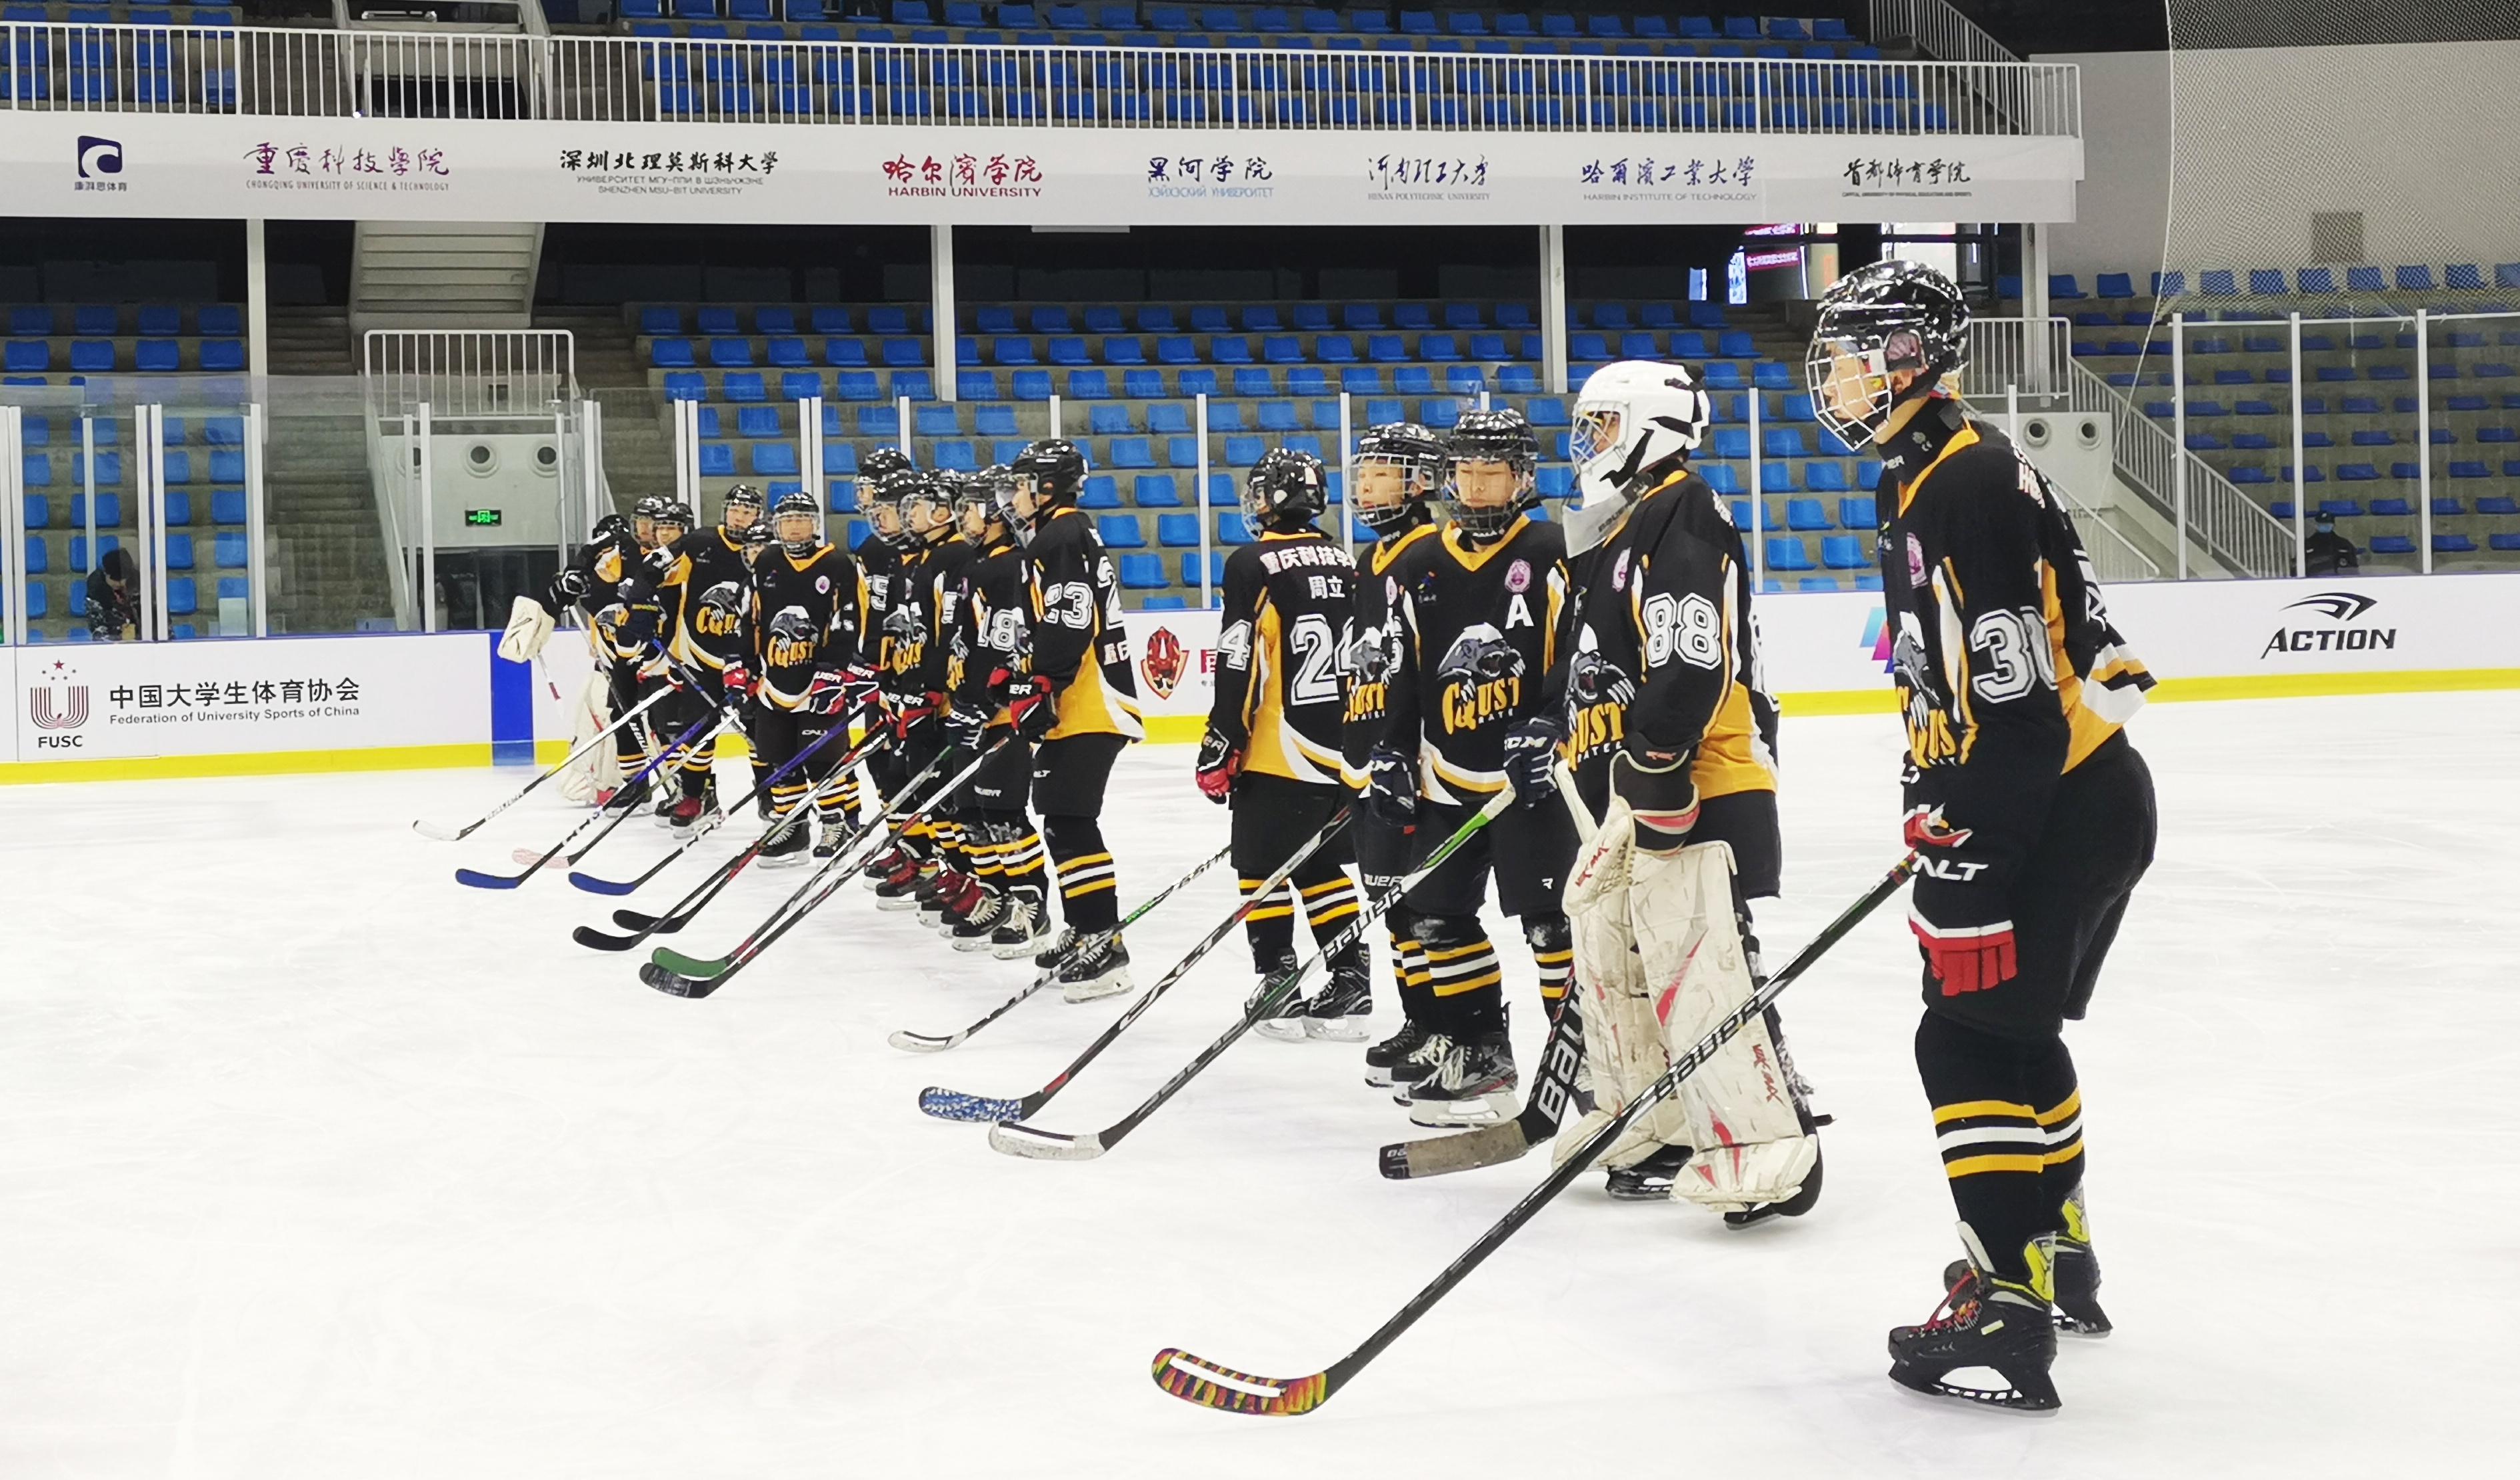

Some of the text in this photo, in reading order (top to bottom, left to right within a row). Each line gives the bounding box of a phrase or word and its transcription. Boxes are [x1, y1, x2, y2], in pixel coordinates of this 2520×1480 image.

[1148, 155, 1273, 183] 黑河学院
[246, 179, 294, 190] CHONGQING
[297, 180, 341, 190] UNIVERSITY
[343, 181, 353, 190] OF
[356, 181, 387, 191] SCIENCE
[399, 181, 450, 191] TECHNOLOGY
[598, 185, 743, 195] SHENZHEN MSU-BIT UNIVERSITY
[888, 187, 1041, 197] HARBIN UNIVERSITY
[1368, 192, 1491, 201] HENAN POLYTECHNIC UNIVERSITY
[1583, 193, 1757, 201] HARBIN INSTITUTE OF TECHNOLOGY
[865, 574, 889, 611] 5
[1308, 575, 1345, 599] 周立
[1505, 594, 1535, 629] A
[1642, 592, 1722, 670] 88
[2260, 627, 2397, 659] ACTION
[1217, 619, 1252, 671] 4
[110, 677, 359, 709] 中国大学生体育协会
[1442, 675, 1521, 735] CQUST
[110, 705, 359, 725] Federation of University Sports of China
[38, 735, 83, 749] FUSC
